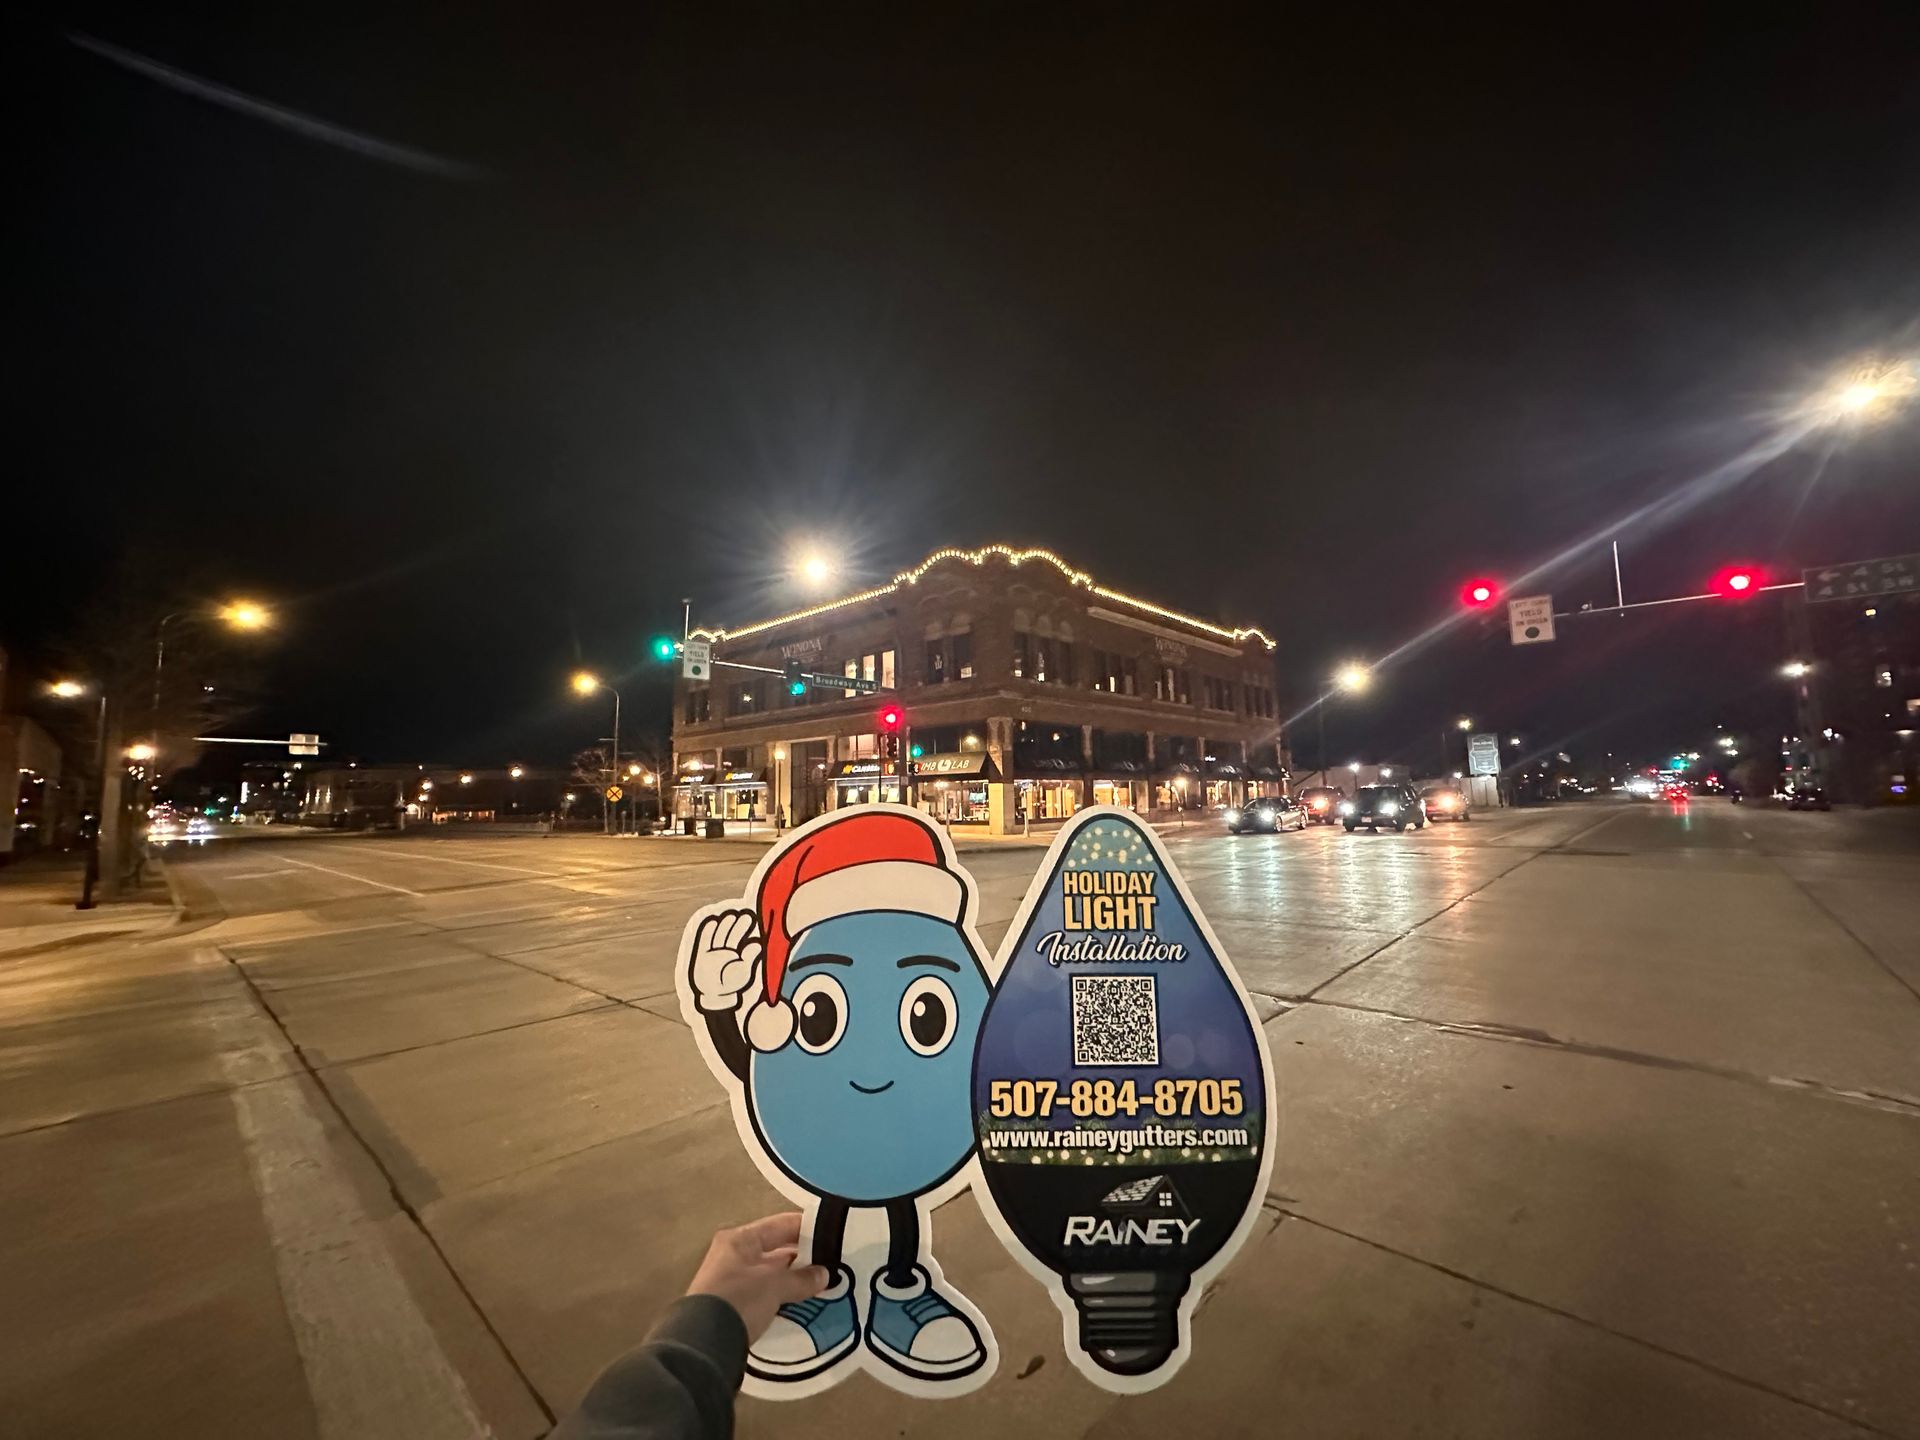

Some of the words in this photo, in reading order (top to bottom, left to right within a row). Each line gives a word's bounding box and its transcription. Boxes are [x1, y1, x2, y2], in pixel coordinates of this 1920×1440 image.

[815, 676, 853, 688] Broadway
[856, 681, 870, 690] Ave
[1063, 871, 1156, 895] HOLIDAY
[1064, 896, 1157, 930] LIGHT
[1036, 932, 1187, 966] Installation
[990, 1079, 1244, 1117] 507-884-8705
[989, 1126, 1249, 1153] www.raineygutters.com
[1063, 1216, 1201, 1246] RAINEY
